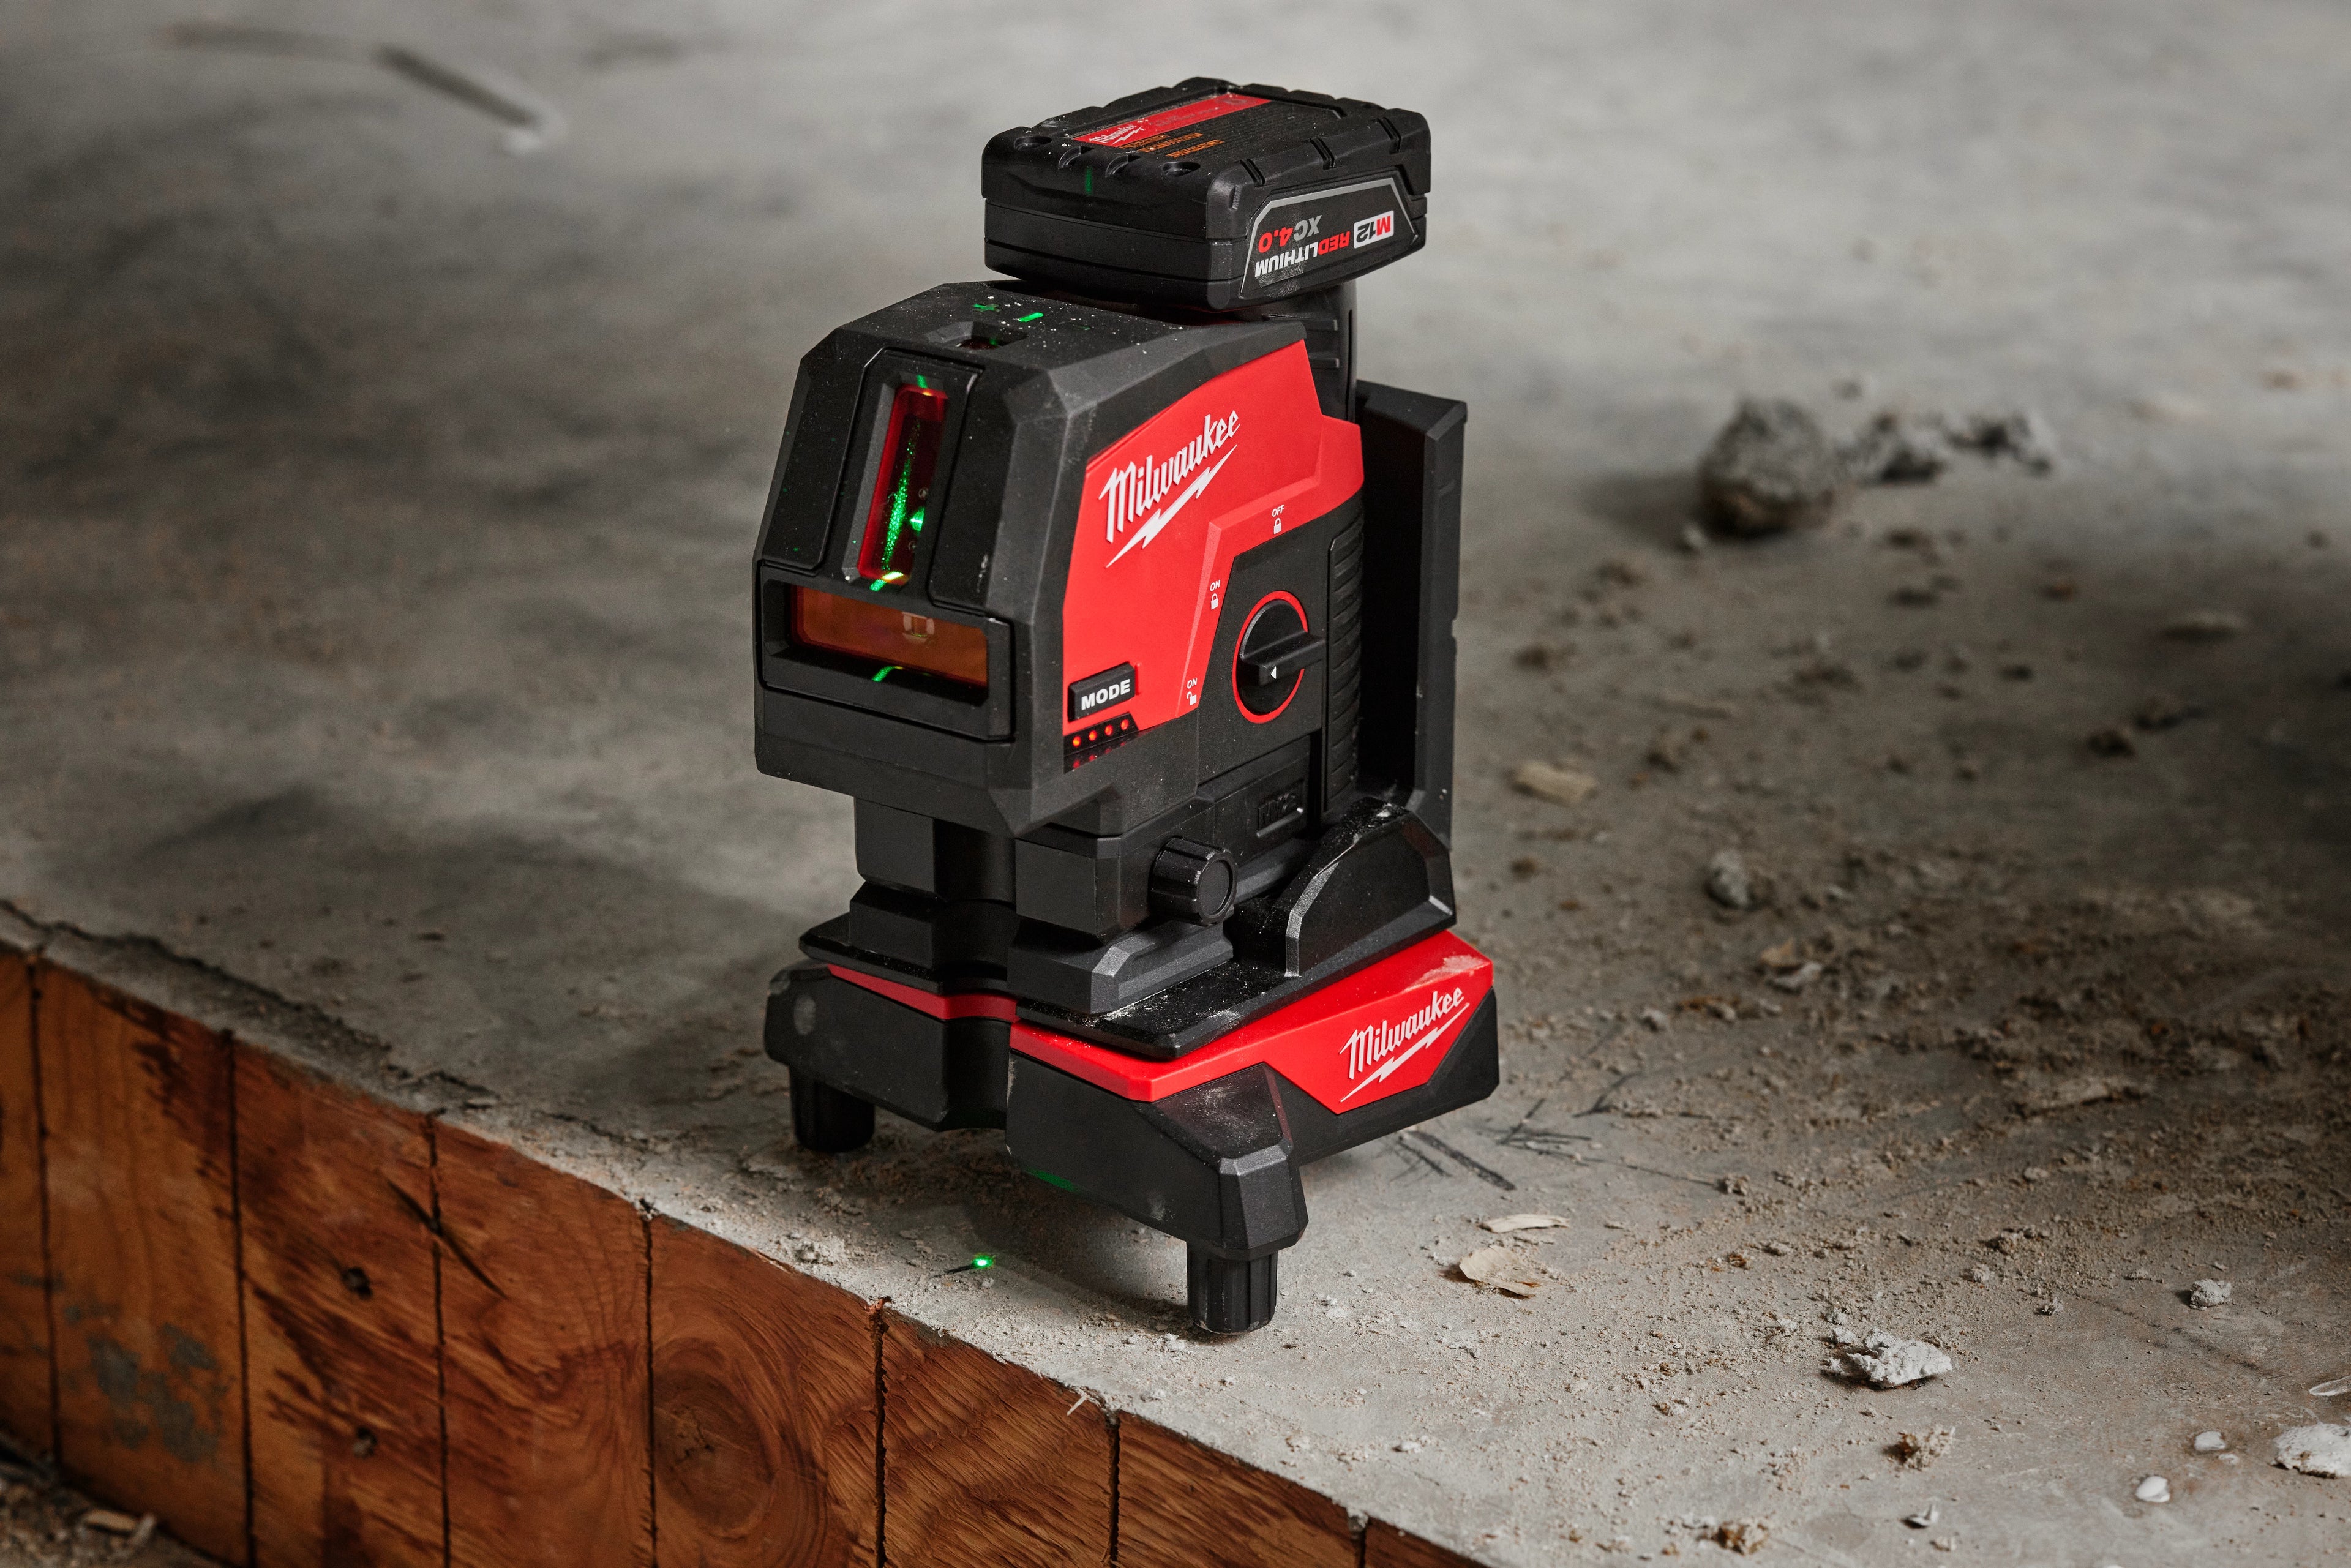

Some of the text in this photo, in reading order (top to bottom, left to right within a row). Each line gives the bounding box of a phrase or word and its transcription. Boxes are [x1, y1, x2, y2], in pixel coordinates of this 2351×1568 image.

[1089, 124, 1137, 144] Milwaukee
[1355, 215, 1391, 243] M12
[1098, 410, 1240, 543] Milwaukee
[1272, 505, 1284, 517] OFF
[1210, 580, 1220, 591] ON
[1081, 679, 1130, 710] MODE
[1187, 677, 1198, 688] ON
[1339, 987, 1464, 1080] Milwaukee
